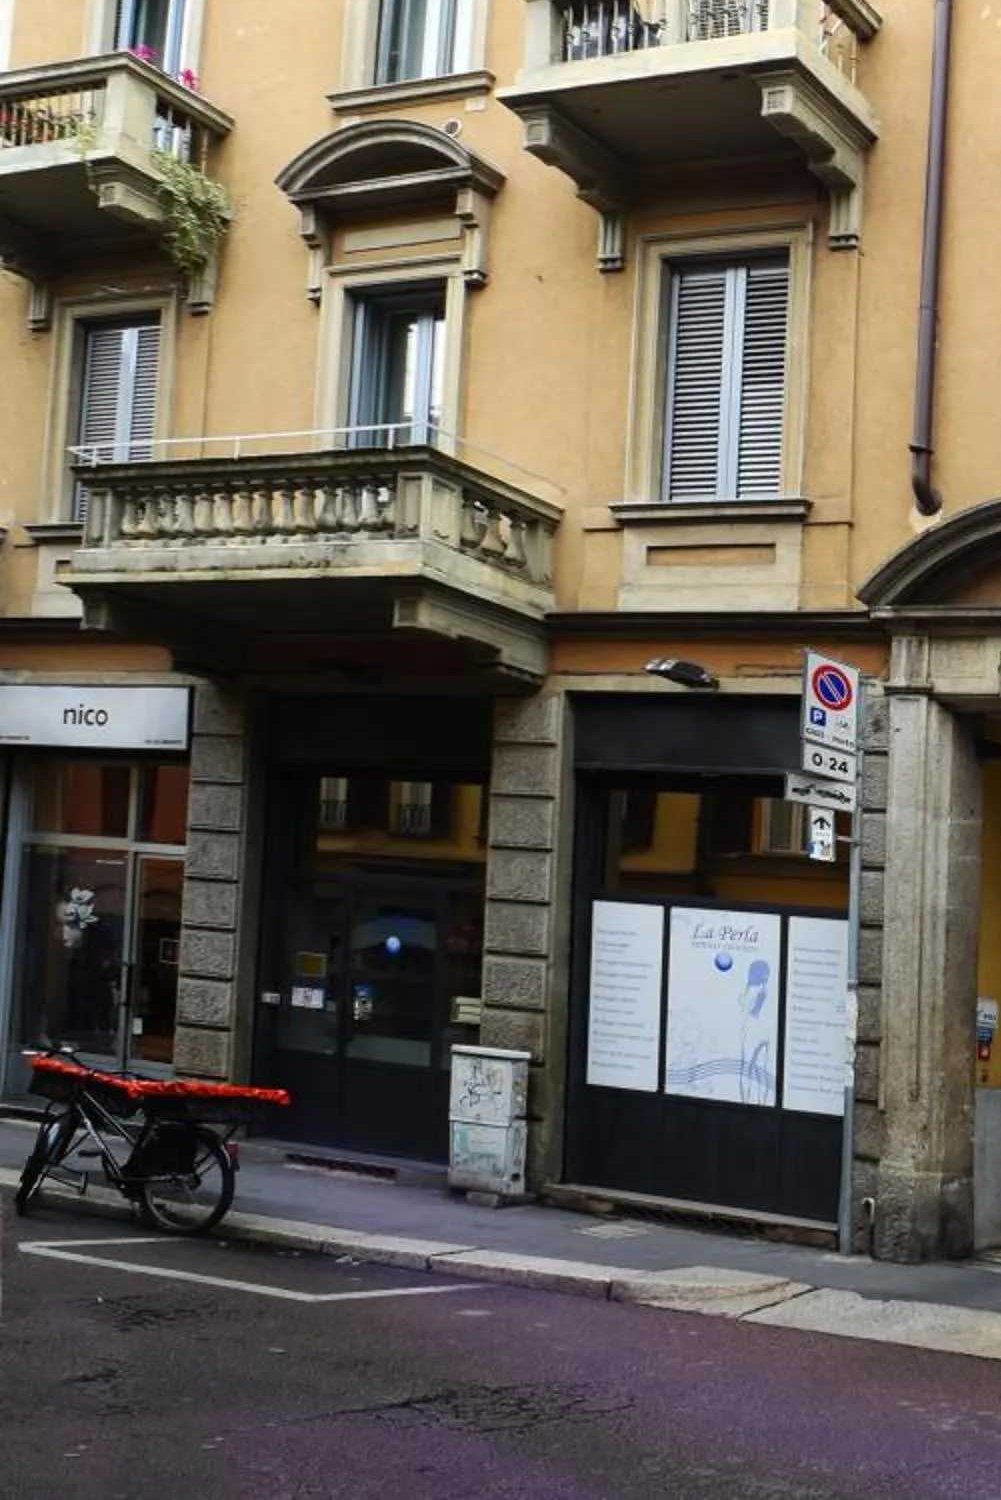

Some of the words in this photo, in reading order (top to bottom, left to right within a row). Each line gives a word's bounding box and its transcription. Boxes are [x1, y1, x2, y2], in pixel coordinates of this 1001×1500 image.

[63, 703, 109, 726] nico
[692, 923, 715, 940] La
[719, 925, 760, 943] Perla
